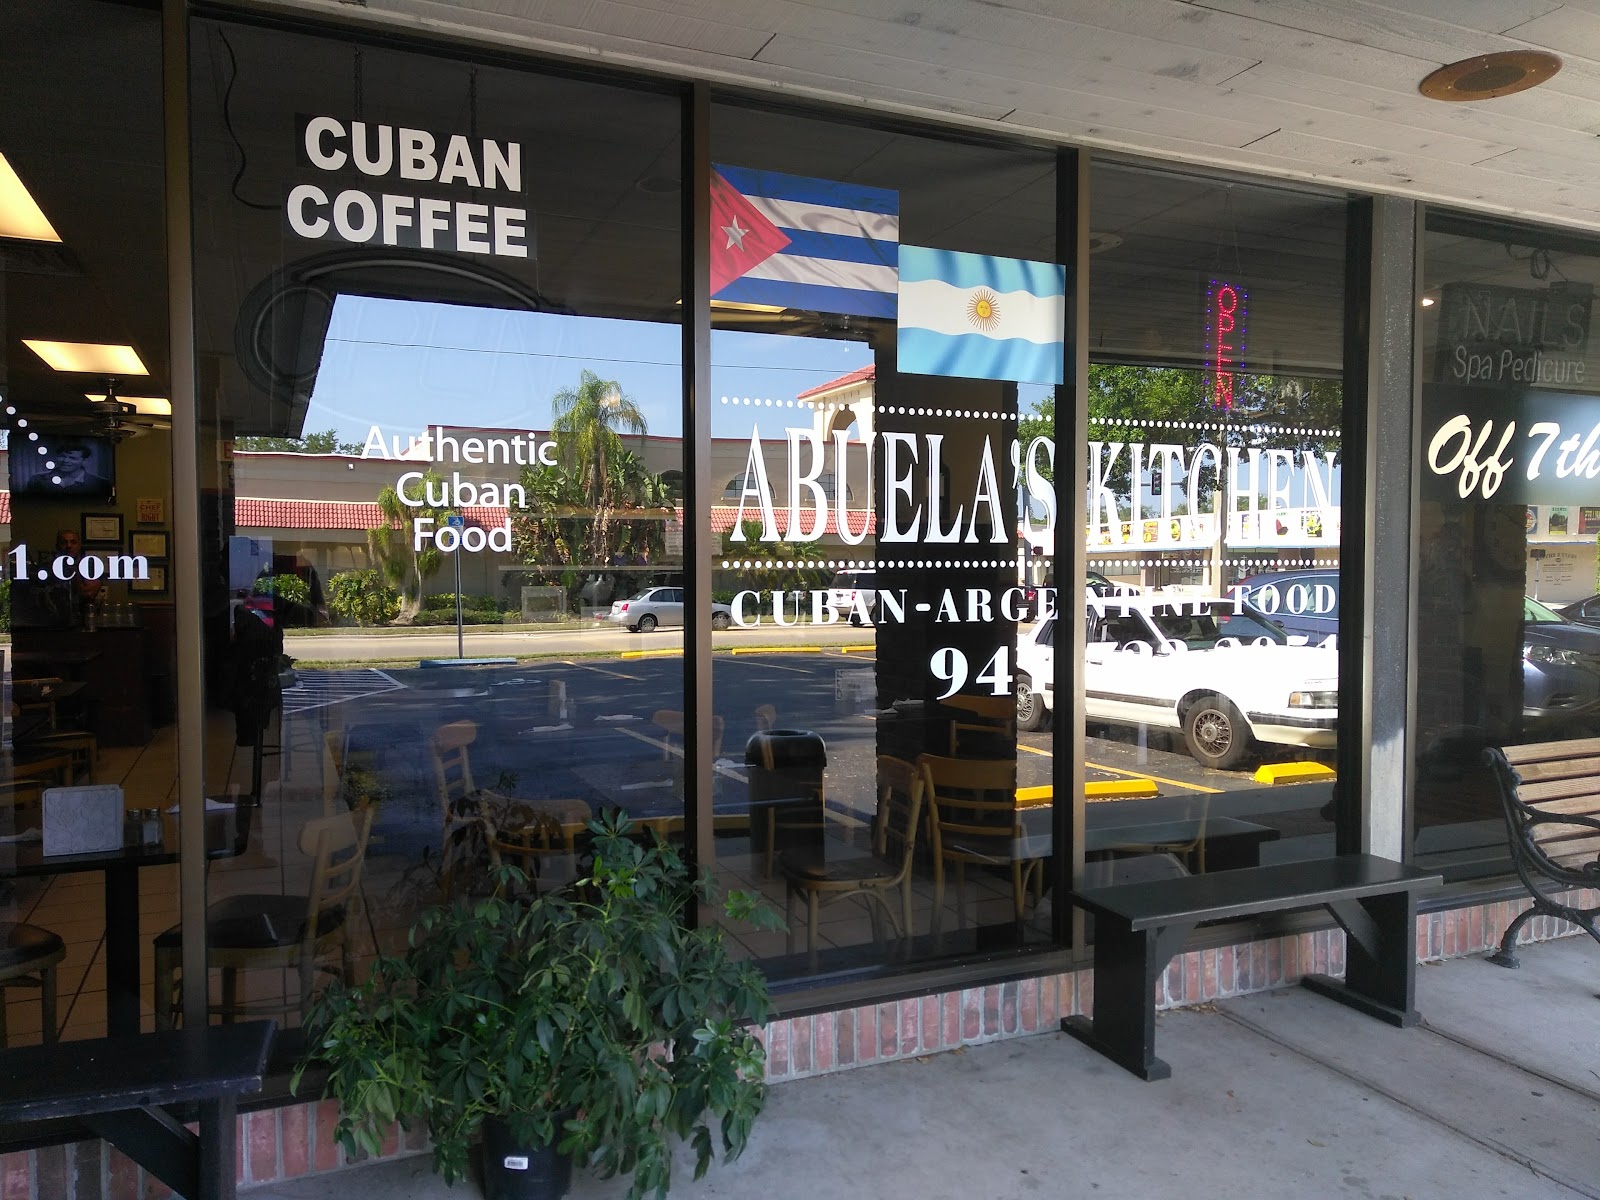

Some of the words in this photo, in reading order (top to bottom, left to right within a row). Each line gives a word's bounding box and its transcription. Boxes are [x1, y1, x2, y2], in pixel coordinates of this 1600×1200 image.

[304, 116, 522, 192] CUBAN
[286, 184, 528, 258] COFFEE
[1462, 295, 1586, 346] NAILS
[1216, 287, 1237, 408] OPEN
[1451, 345, 1493, 385] Spa
[1498, 349, 1586, 384] Pedicure
[361, 425, 558, 466] Authentic
[1428, 414, 1517, 500] Off
[396, 472, 526, 509] Cuban
[729, 423, 1057, 550] ABUELA'S
[1085, 441, 1338, 548] KITCHEN
[413, 517, 513, 553] Food
[0, 543, 150, 581] 1.com
[1227, 583, 1337, 616] FOOD
